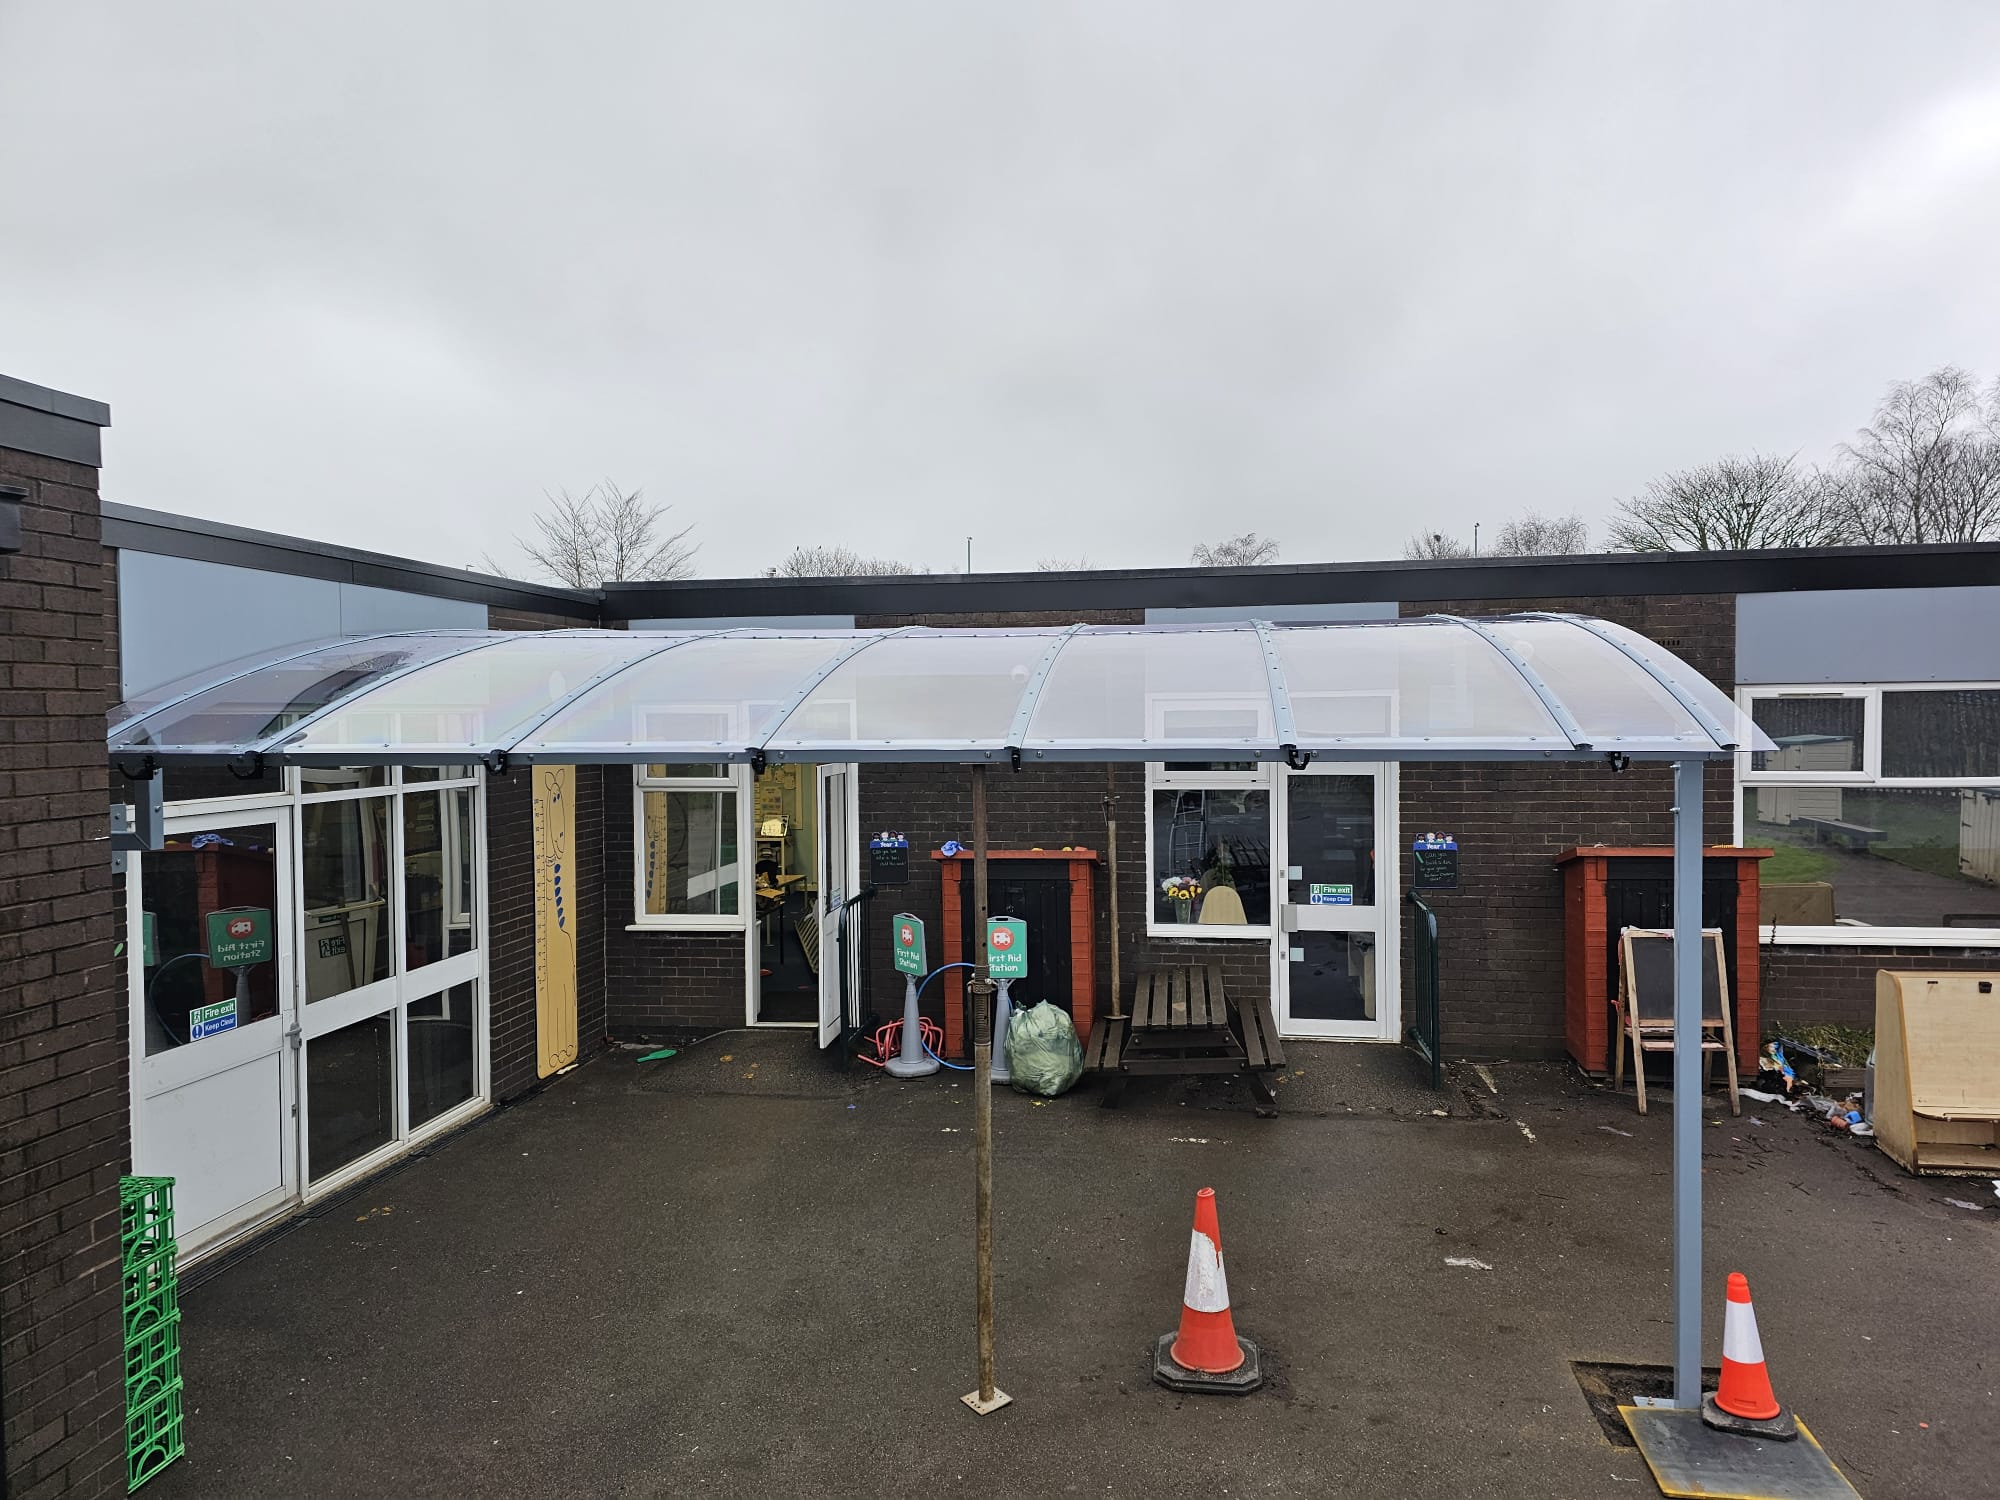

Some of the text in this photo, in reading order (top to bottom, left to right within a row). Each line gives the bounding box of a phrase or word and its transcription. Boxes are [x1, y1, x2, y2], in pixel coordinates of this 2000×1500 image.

[1337, 886, 1351, 894] exit
[896, 947, 920, 961] First Aid
[988, 953, 1022, 962] irst Aid
[899, 957, 918, 970] Station
[204, 1002, 234, 1019] Fire exit
[205, 1017, 235, 1032] Keep Clear
